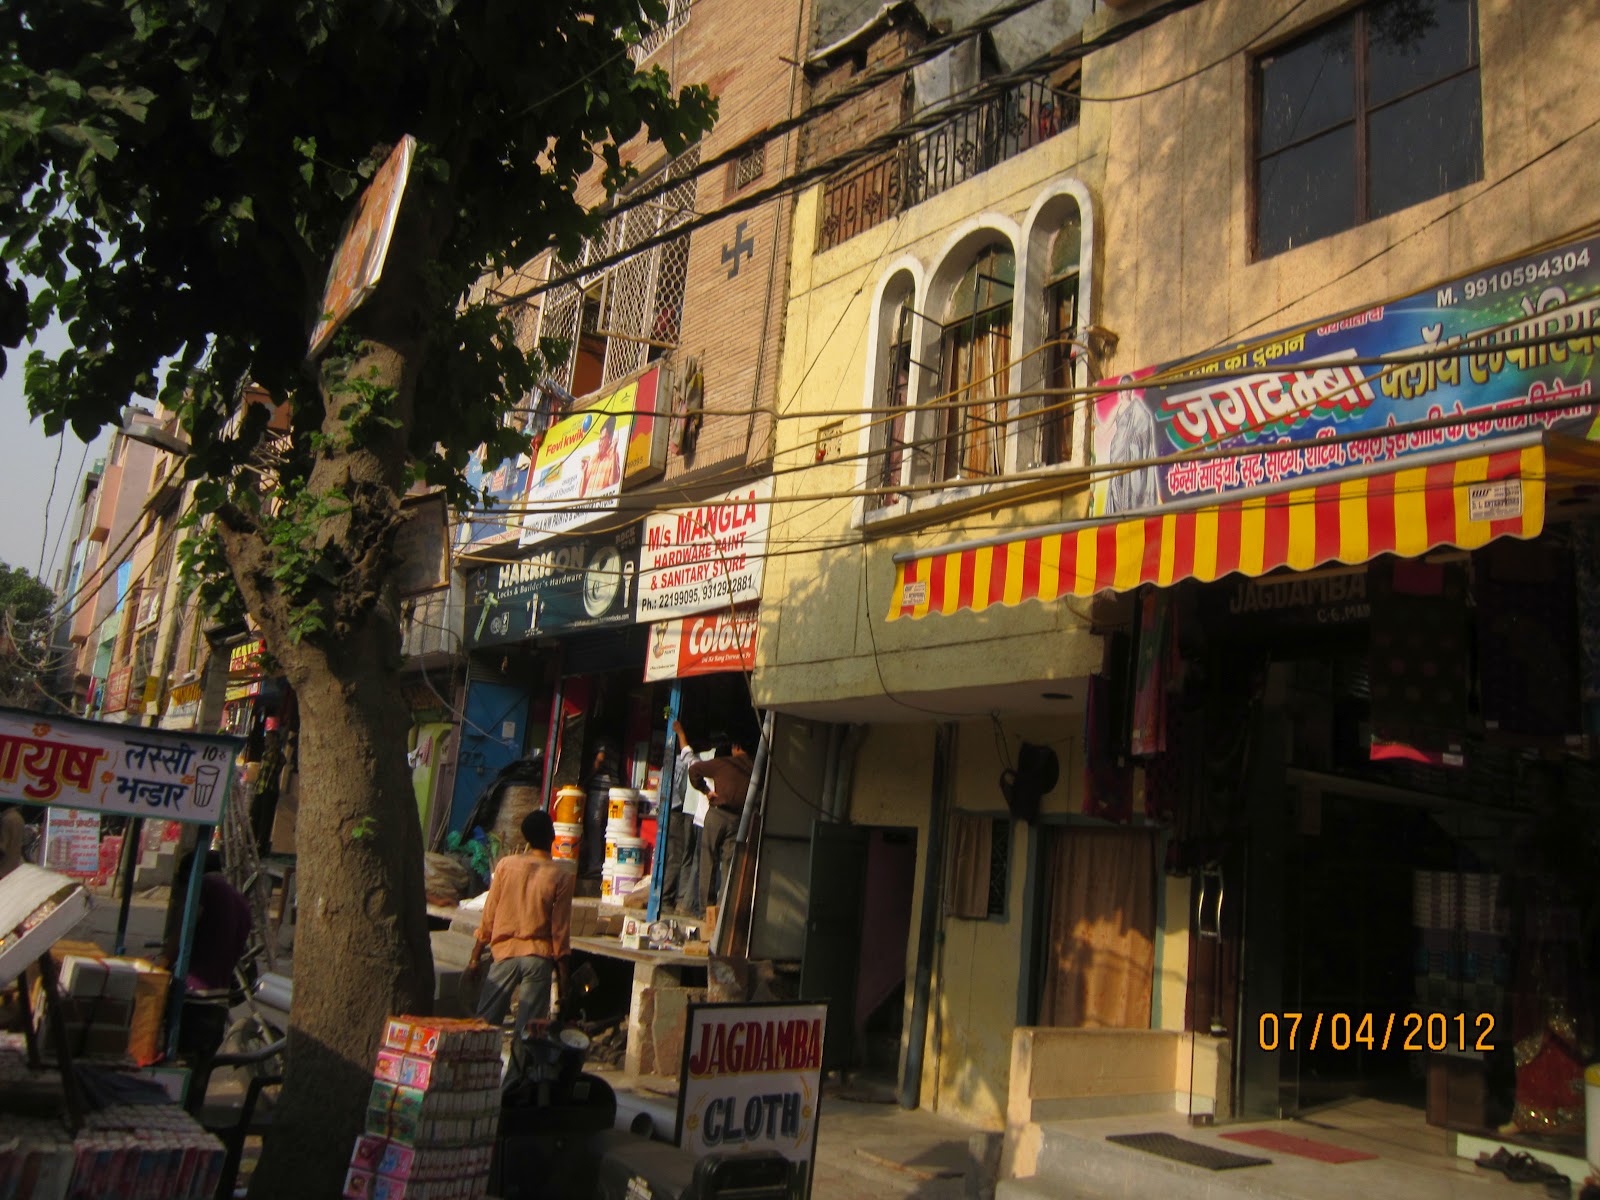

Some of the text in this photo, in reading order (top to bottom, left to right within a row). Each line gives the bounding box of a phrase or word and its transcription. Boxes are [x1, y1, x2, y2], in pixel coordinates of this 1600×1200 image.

[1437, 247, 1590, 308] M. 9910594304
[1252, 333, 1306, 367] दुकान
[1164, 347, 1376, 440] जगदम्बा
[648, 490, 757, 552] M/s MANGLA
[498, 544, 585, 589] HARRISON
[654, 531, 747, 569] HARDWARE PAINT
[549, 573, 583, 587] Hardware
[650, 552, 747, 591] & SANITARY STORE
[659, 588, 701, 609] 22199095,
[689, 618, 758, 656] Colour
[124, 740, 197, 775] लस्सी
[202, 745, 218, 761] 10
[116, 776, 191, 811] भन्डार
[689, 1018, 822, 1076] JAGDAMBA
[703, 1092, 800, 1147] CLOTH
